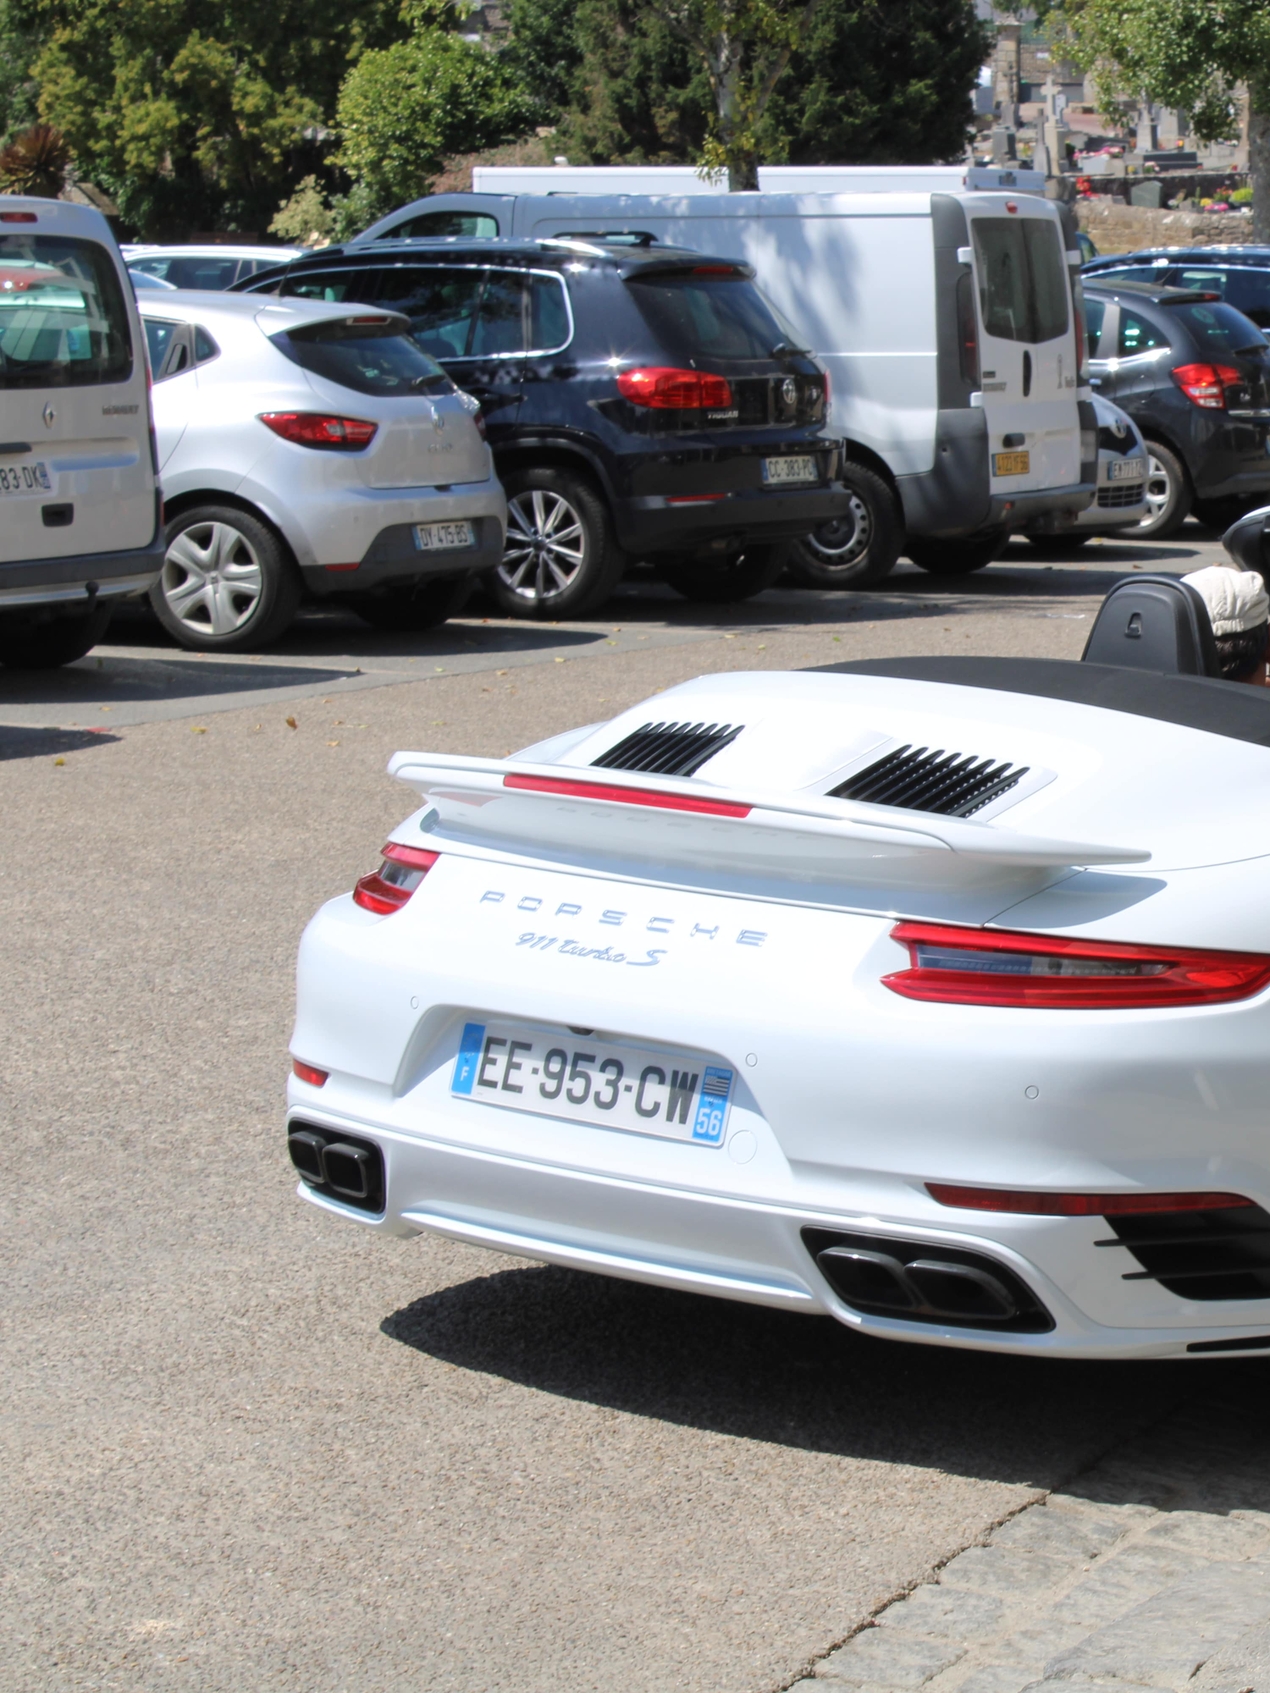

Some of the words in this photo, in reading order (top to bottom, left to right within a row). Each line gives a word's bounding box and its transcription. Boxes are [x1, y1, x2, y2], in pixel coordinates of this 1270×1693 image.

[768, 459, 812, 478] CC-383-PC
[420, 525, 468, 547] DY-475-BS
[479, 890, 768, 947] PORSCHE
[515, 931, 560, 952] 911
[626, 948, 668, 967] S
[459, 1066, 470, 1082] F
[477, 1036, 699, 1125] EE-953-CW
[695, 1107, 723, 1136] 56
